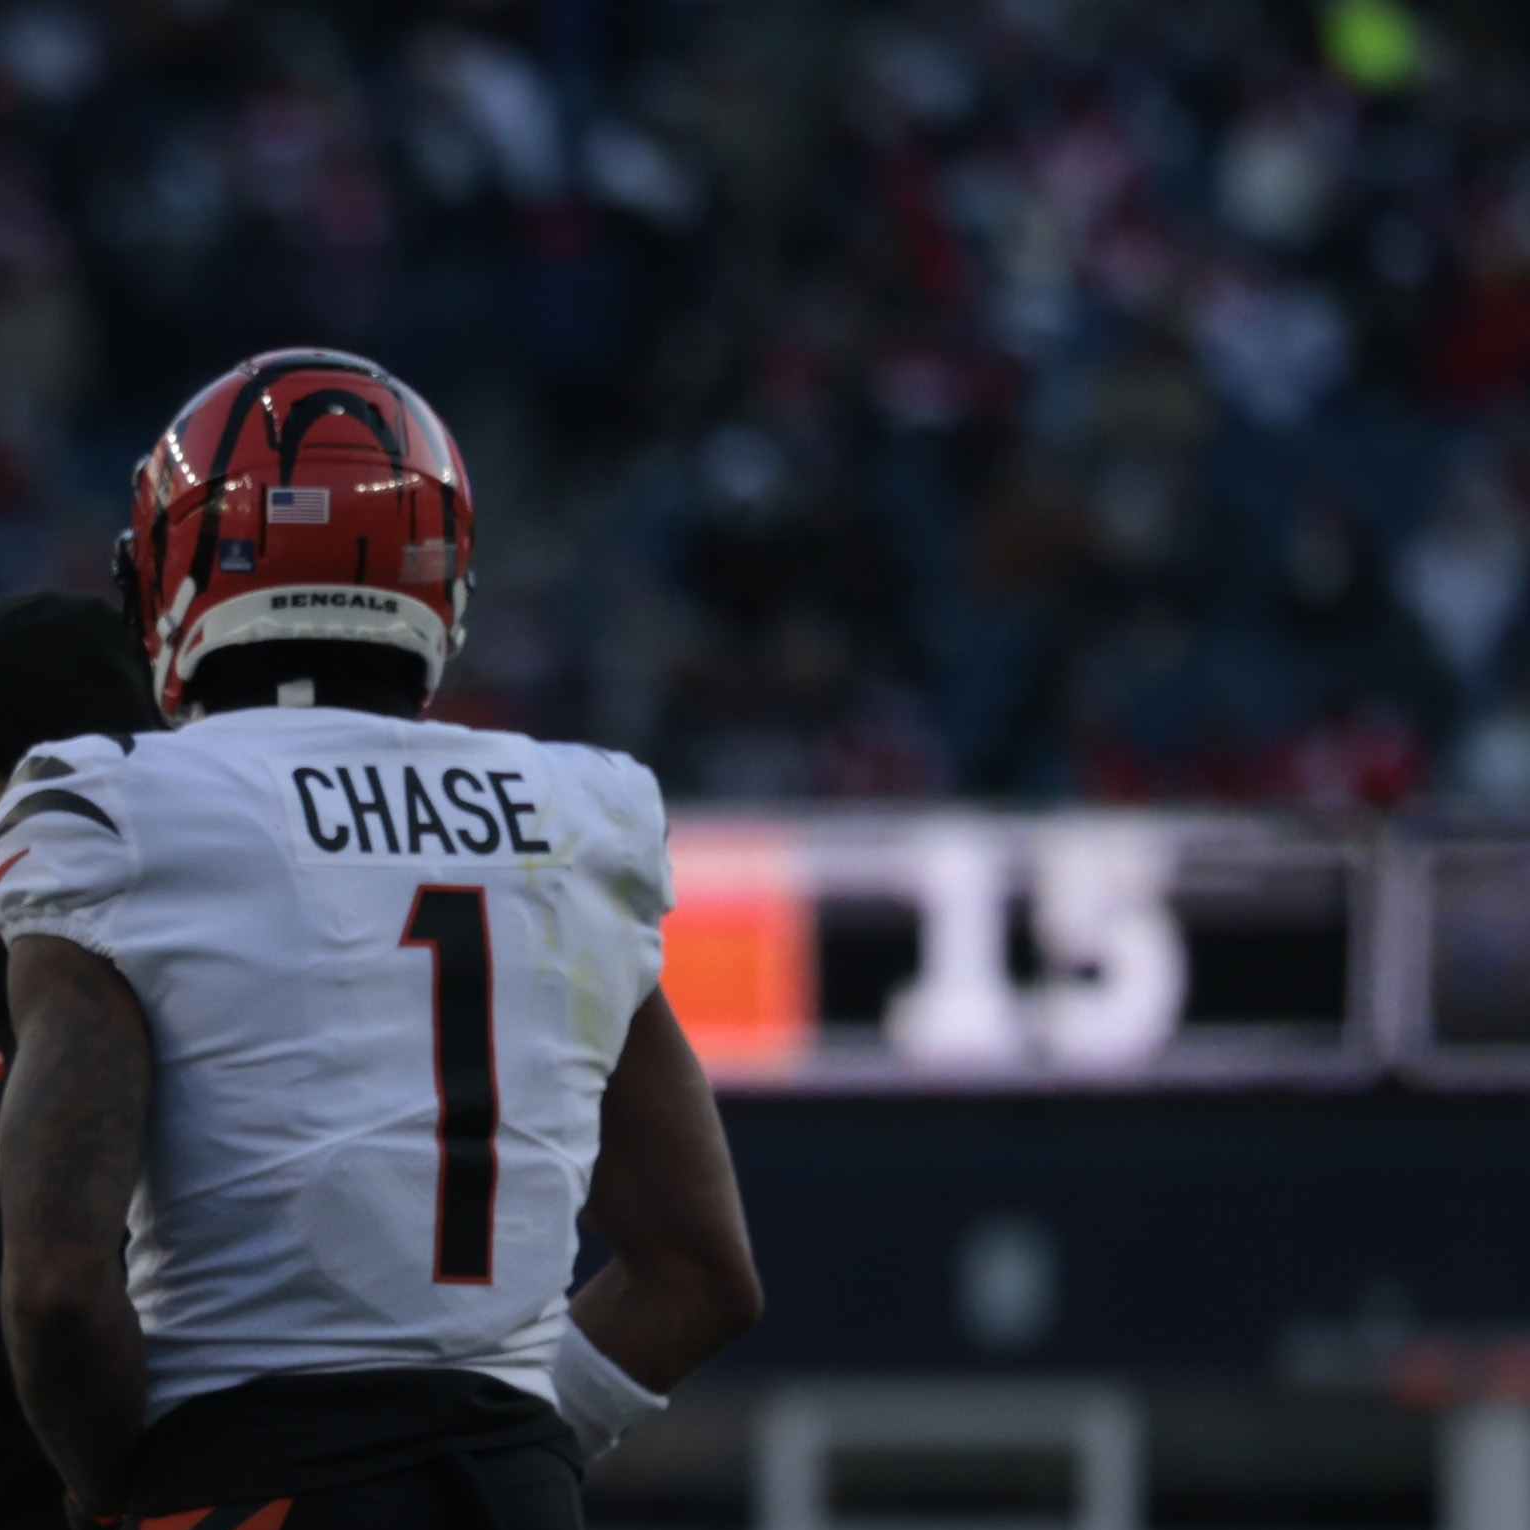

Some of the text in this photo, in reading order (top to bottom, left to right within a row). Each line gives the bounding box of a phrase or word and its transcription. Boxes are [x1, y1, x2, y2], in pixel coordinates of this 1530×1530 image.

[270, 593, 398, 614] BENGALS
[292, 765, 550, 855] CHASE
[885, 818, 1186, 1073] 15
[398, 884, 499, 1284] 1
